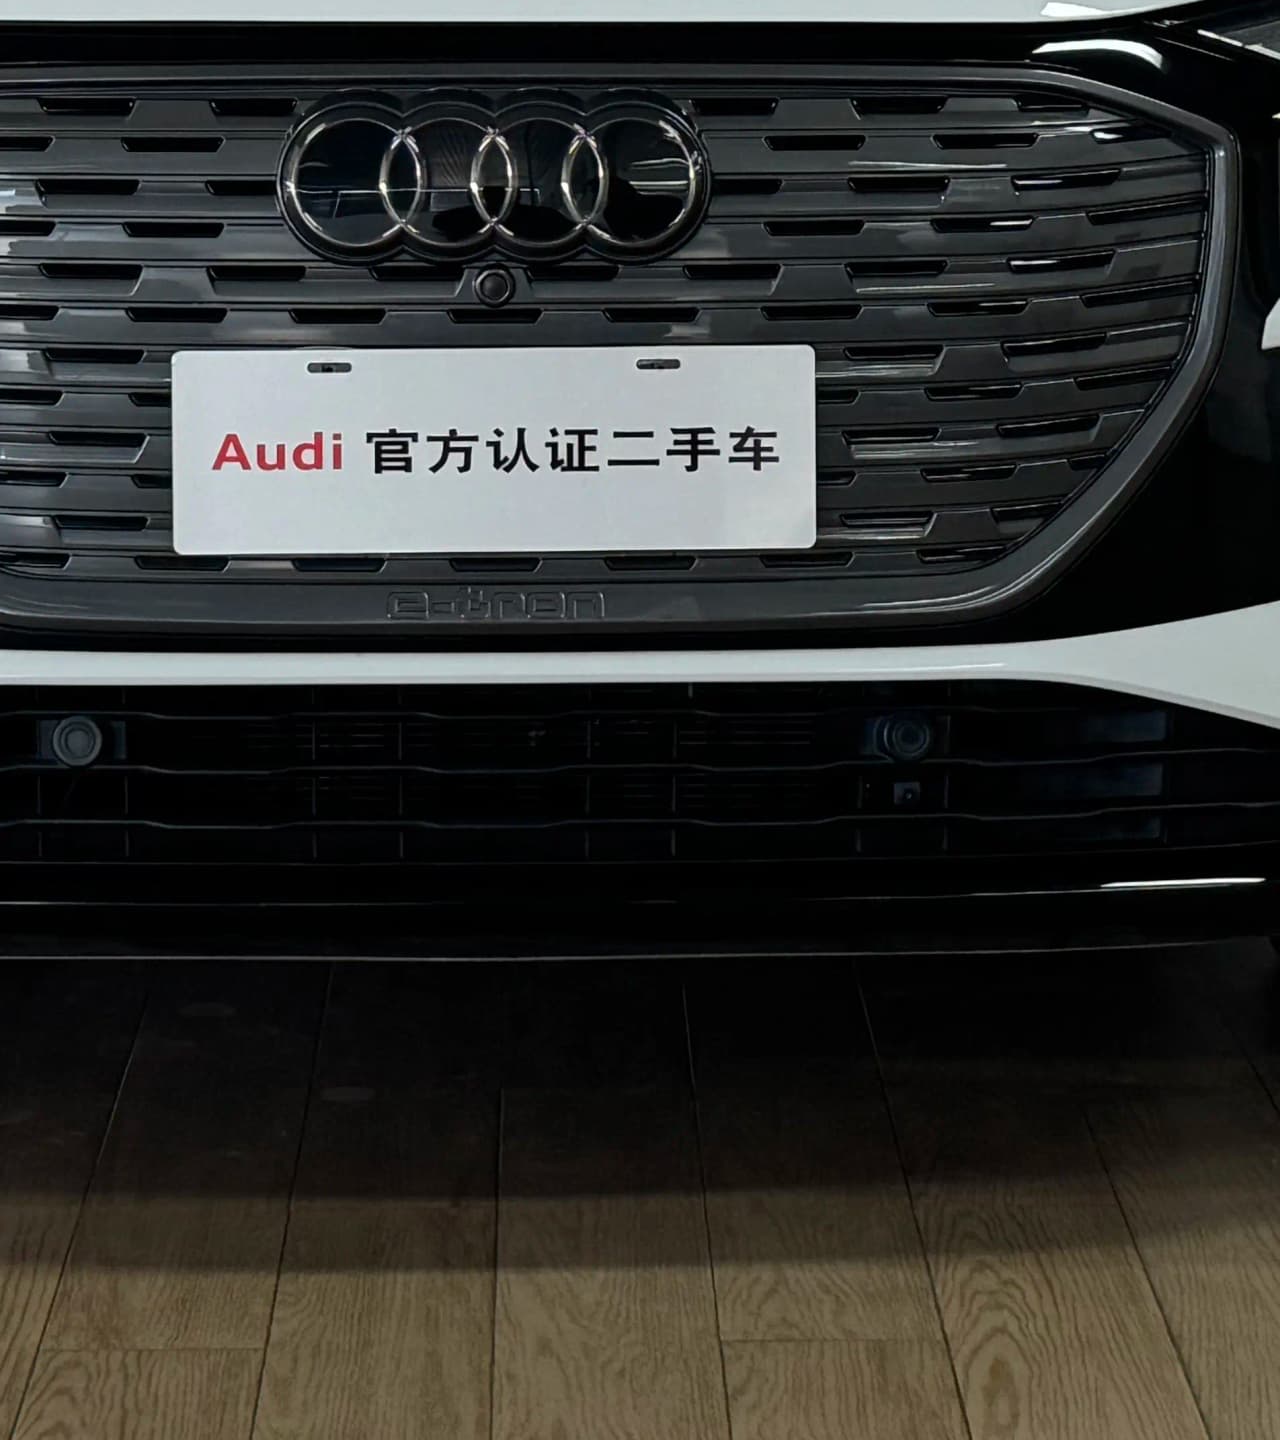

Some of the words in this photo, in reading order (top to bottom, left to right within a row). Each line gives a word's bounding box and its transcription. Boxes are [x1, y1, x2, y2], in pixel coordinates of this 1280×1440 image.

[211, 431, 344, 471] Audi
[365, 425, 781, 474] 官方认证二手车
